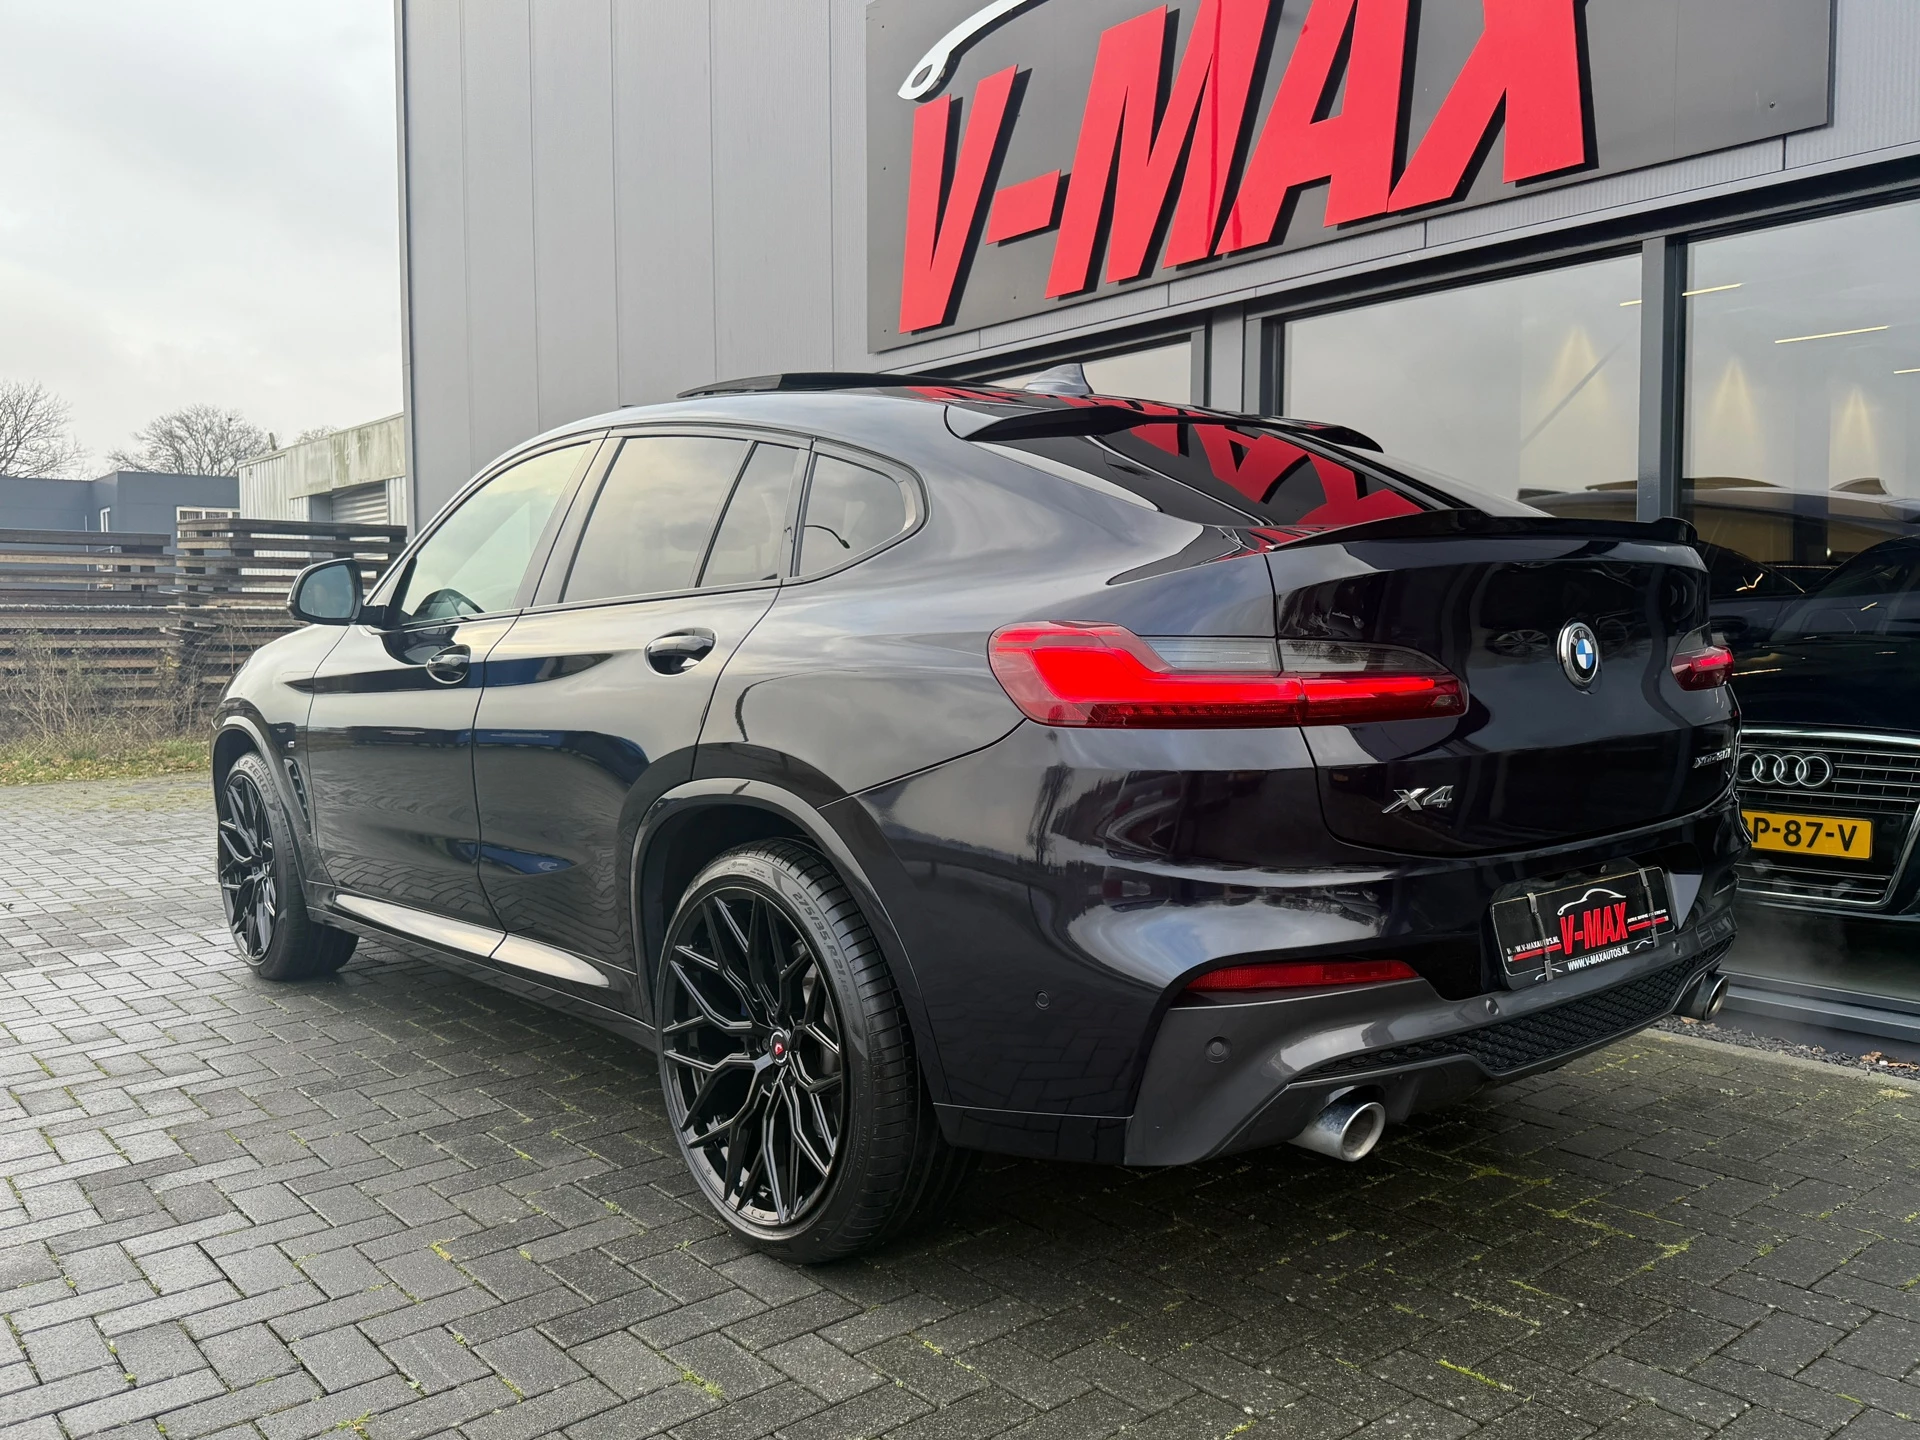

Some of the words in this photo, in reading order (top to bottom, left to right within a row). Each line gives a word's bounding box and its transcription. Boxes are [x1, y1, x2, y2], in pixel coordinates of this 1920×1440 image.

[899, 0, 1585, 334] V-MAX
[1382, 785, 1454, 813] X4
[792, 891, 831, 941] 275/35
[827, 944, 846, 976] R21
[1559, 902, 1629, 955] V-MAX
[1567, 945, 1631, 972] WWW.V-MAXAUTOS.NL
